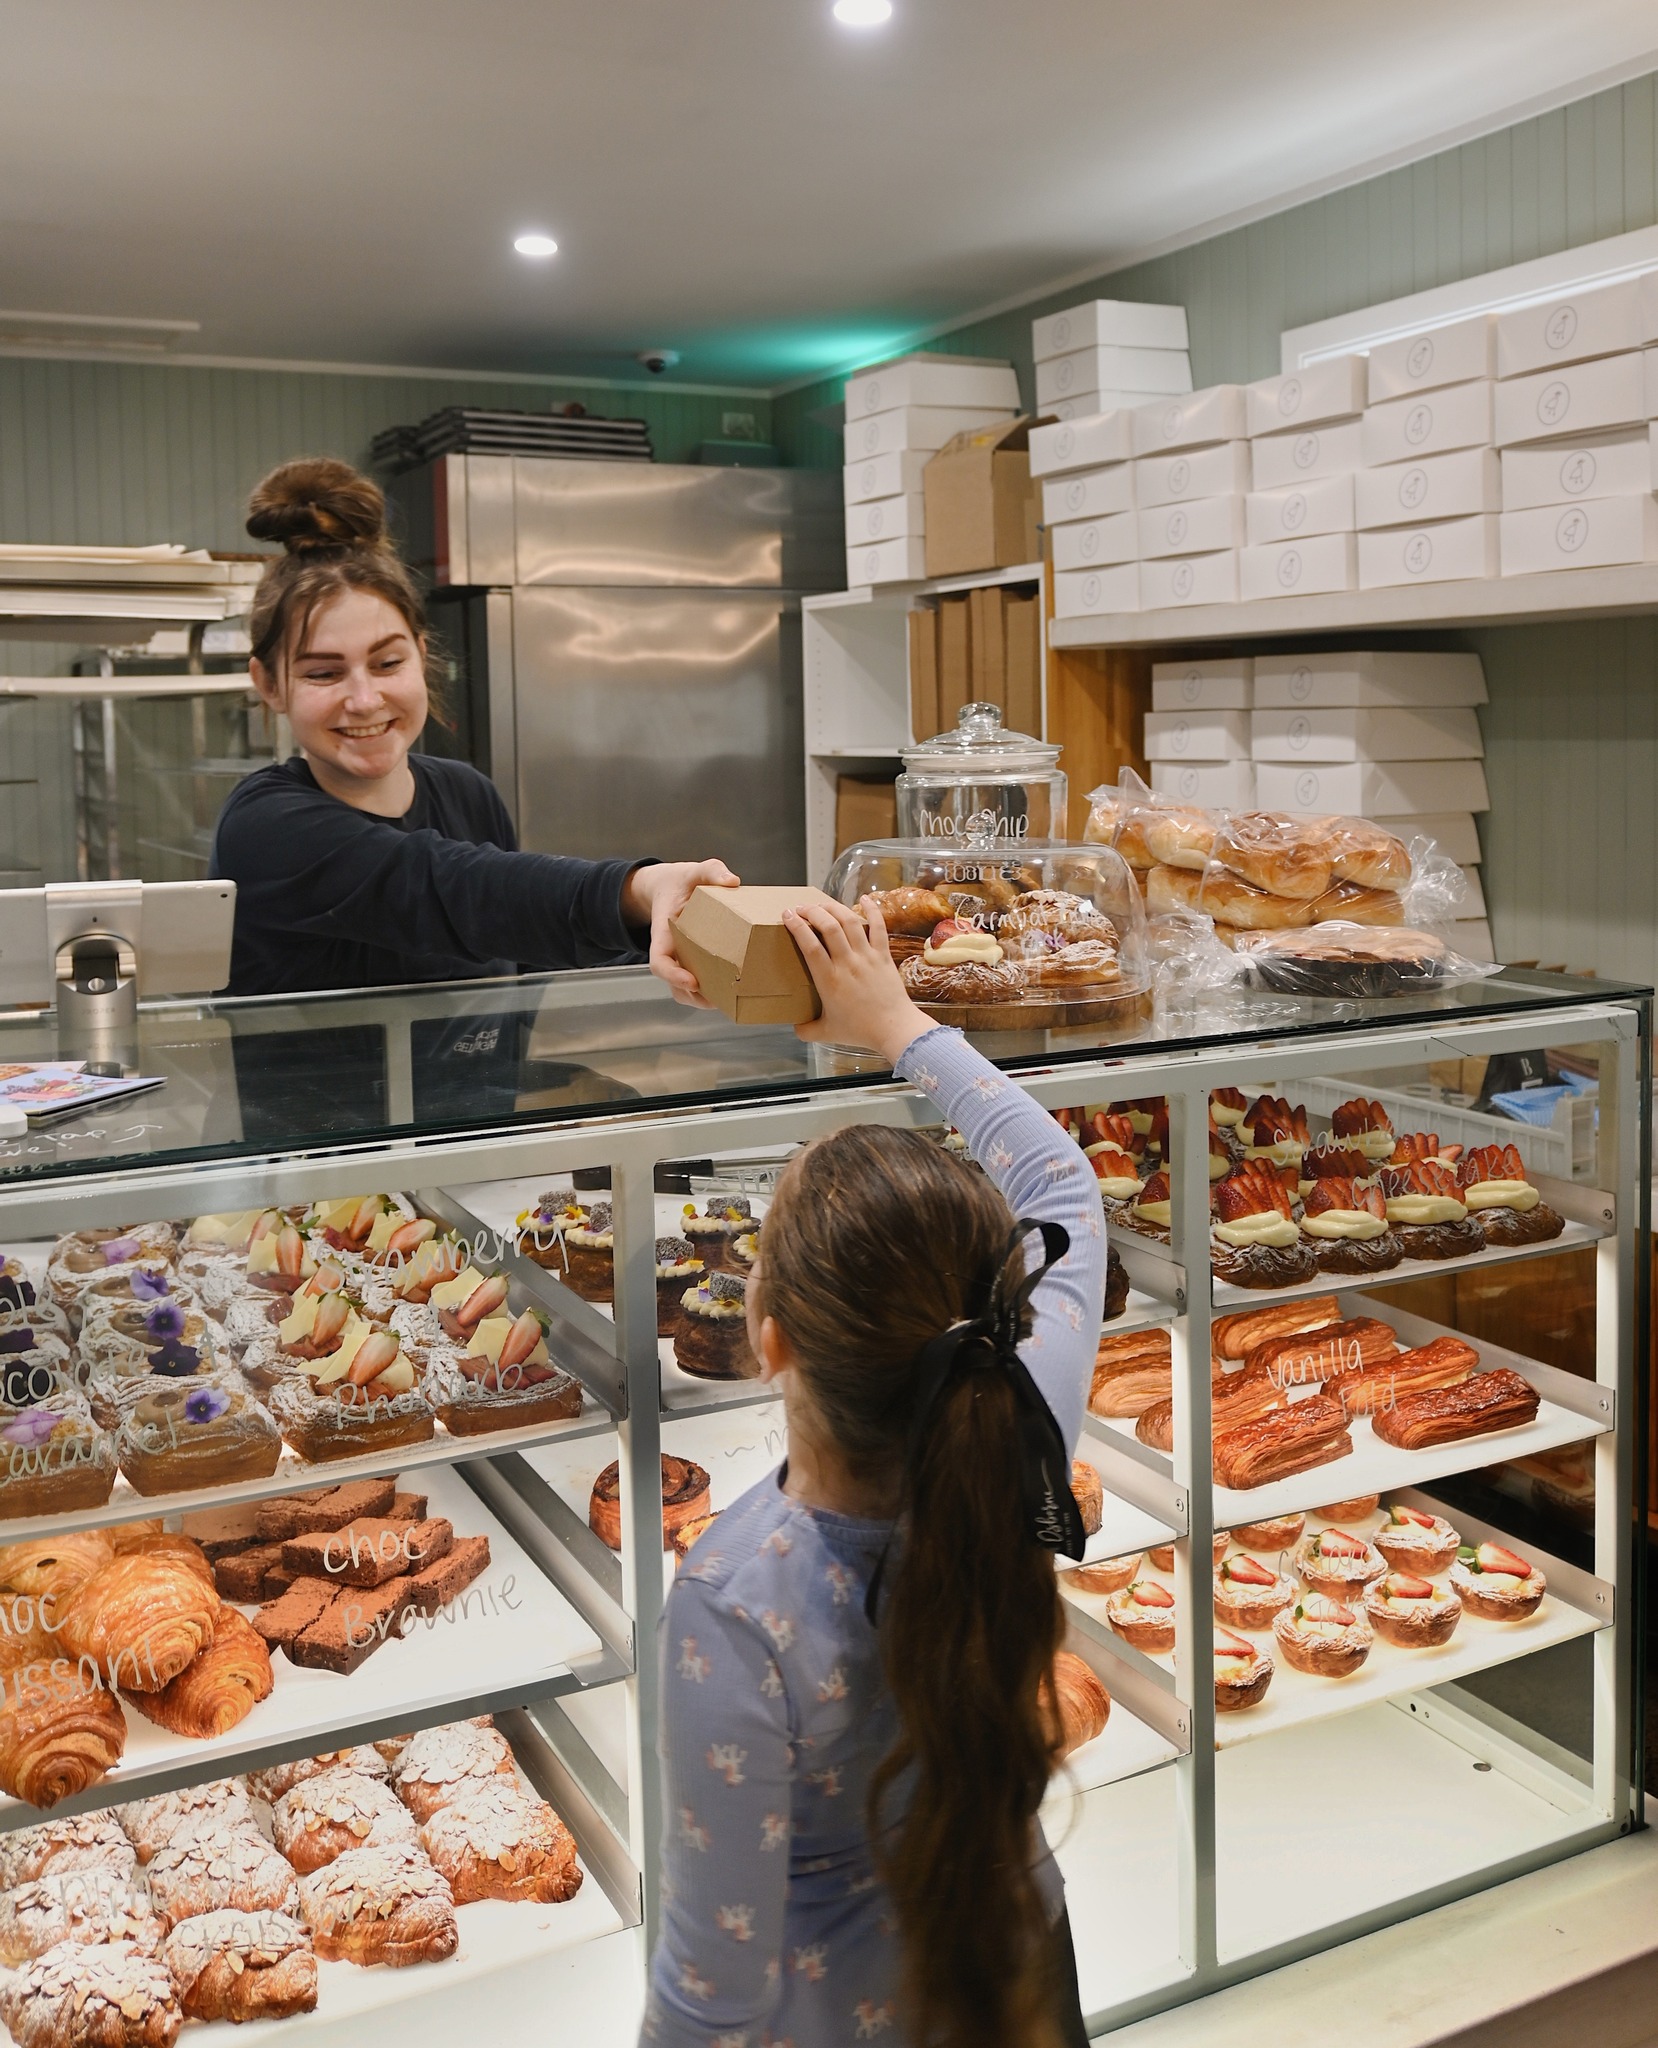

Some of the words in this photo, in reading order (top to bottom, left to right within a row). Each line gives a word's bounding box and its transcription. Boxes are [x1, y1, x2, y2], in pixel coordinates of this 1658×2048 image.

[316, 1223, 569, 1293] Strawberry
[0, 1407, 178, 1488] aramel
[343, 1574, 523, 1648] Brownie
